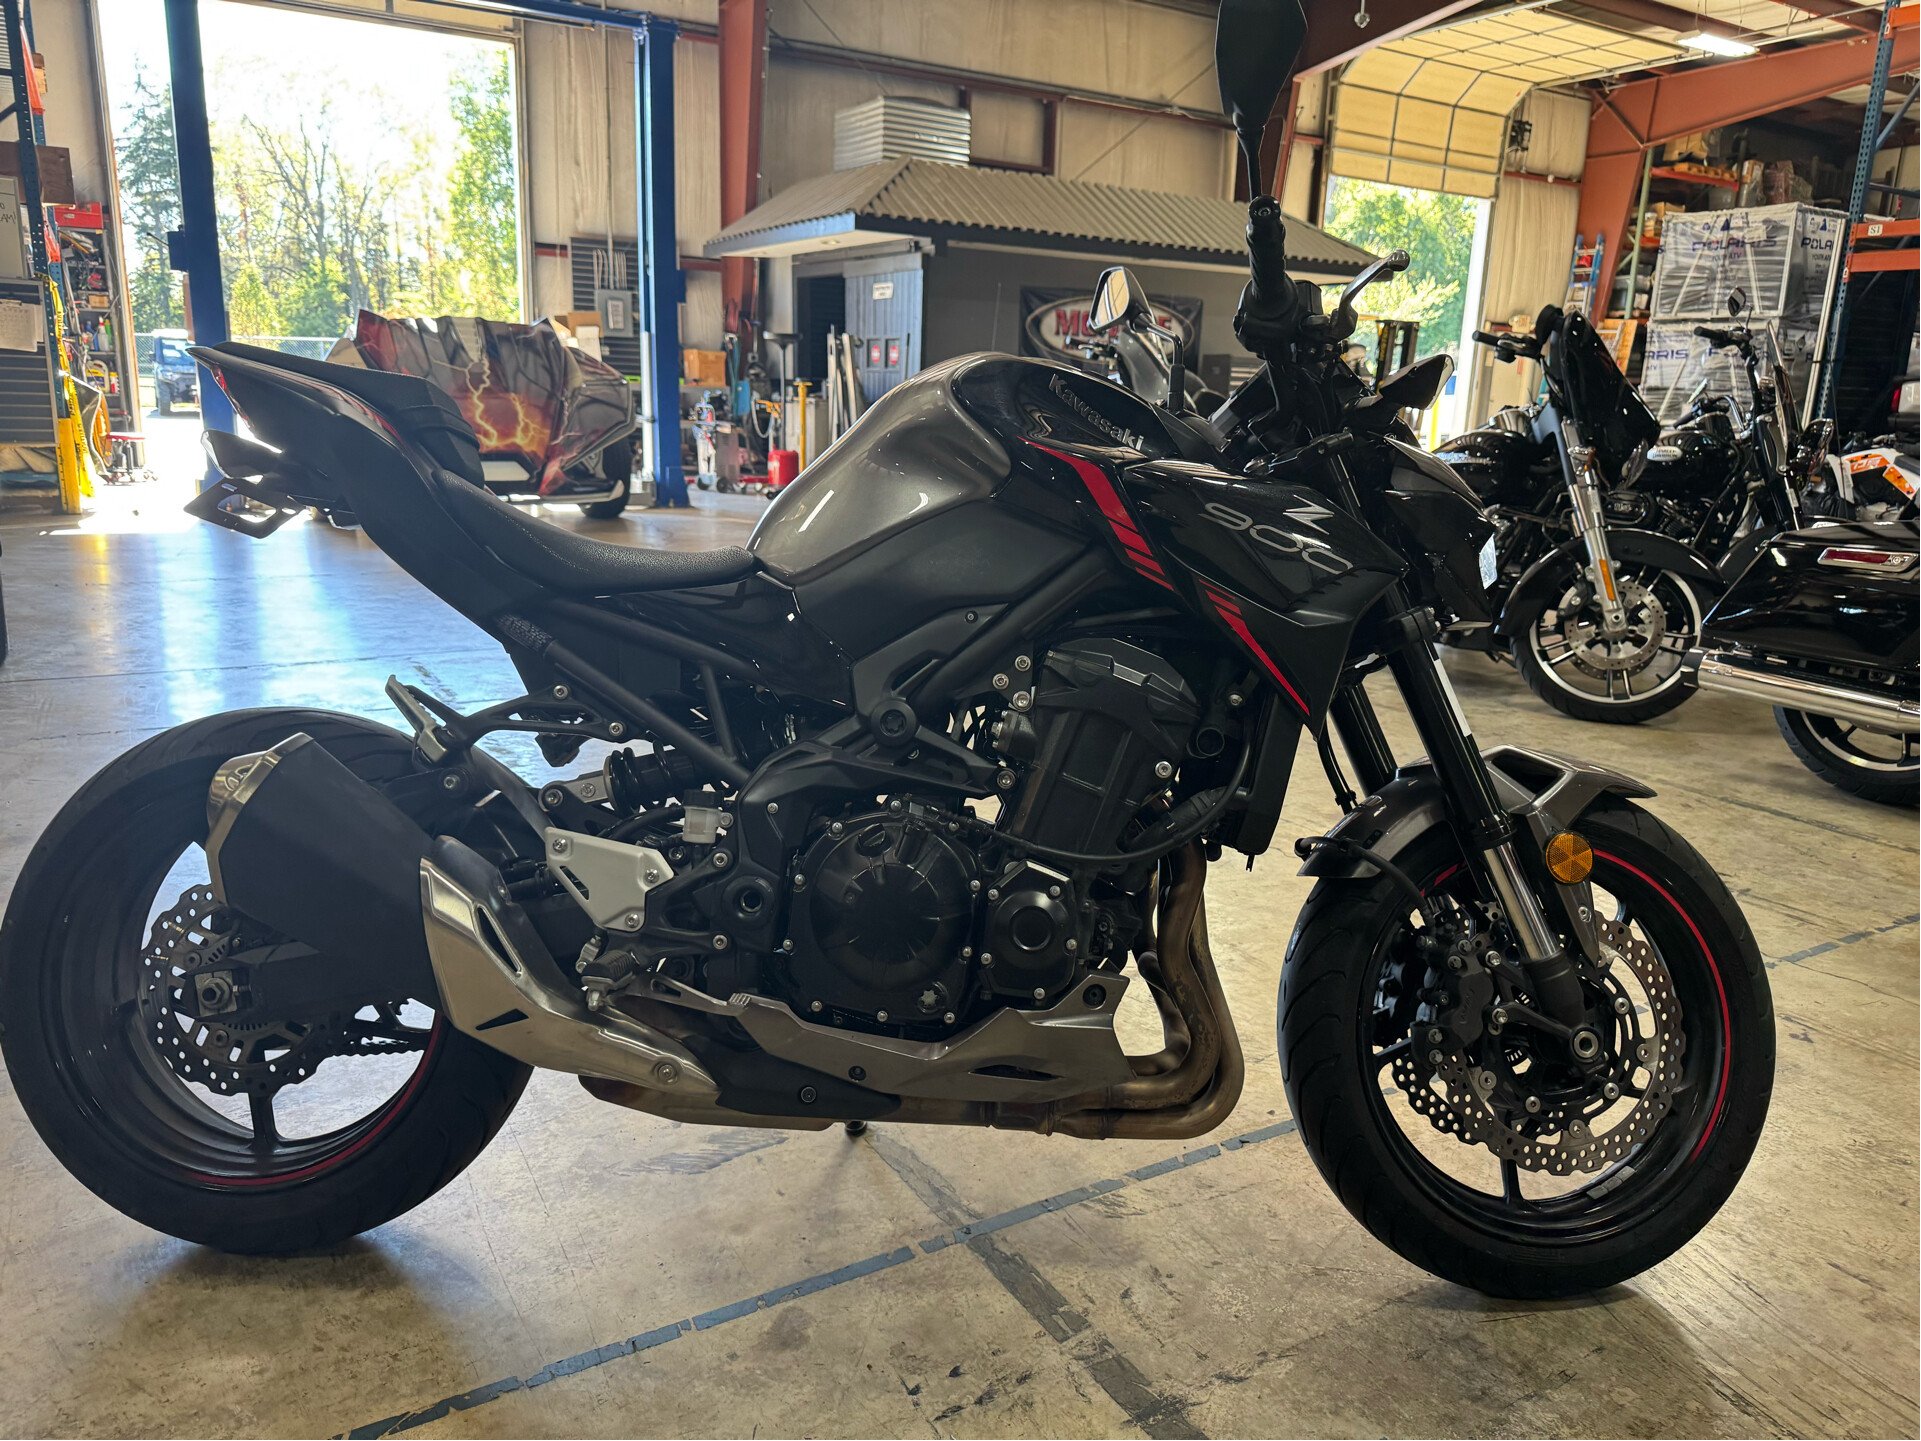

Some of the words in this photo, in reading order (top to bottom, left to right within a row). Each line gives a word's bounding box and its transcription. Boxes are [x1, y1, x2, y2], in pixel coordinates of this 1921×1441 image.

[1801, 237, 1834, 250] POLA
[1048, 373, 1145, 451] Kawasaki
[1200, 502, 1353, 574] 900
